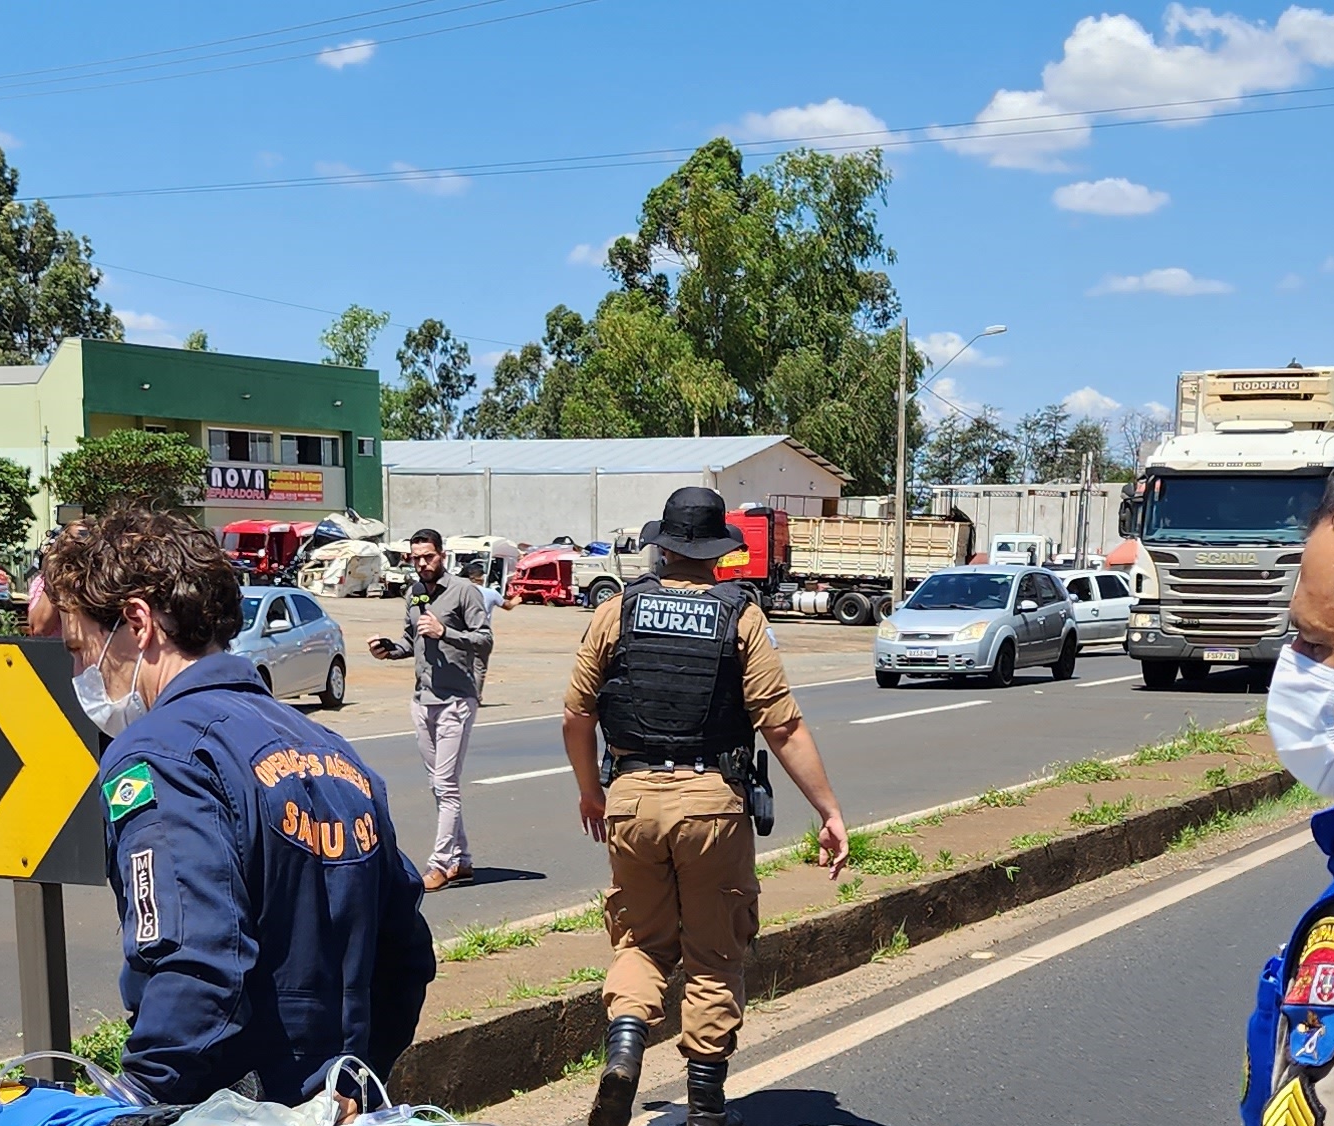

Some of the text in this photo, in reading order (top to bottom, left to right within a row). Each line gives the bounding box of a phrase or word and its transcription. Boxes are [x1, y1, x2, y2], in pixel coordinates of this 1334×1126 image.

[1233, 381, 1299, 390] RODOFRIO
[1195, 552, 1258, 564] SCANIA
[641, 599, 714, 616] PATRULHA
[638, 610, 712, 634] RURAL
[134, 855, 155, 938] MÉDICO
